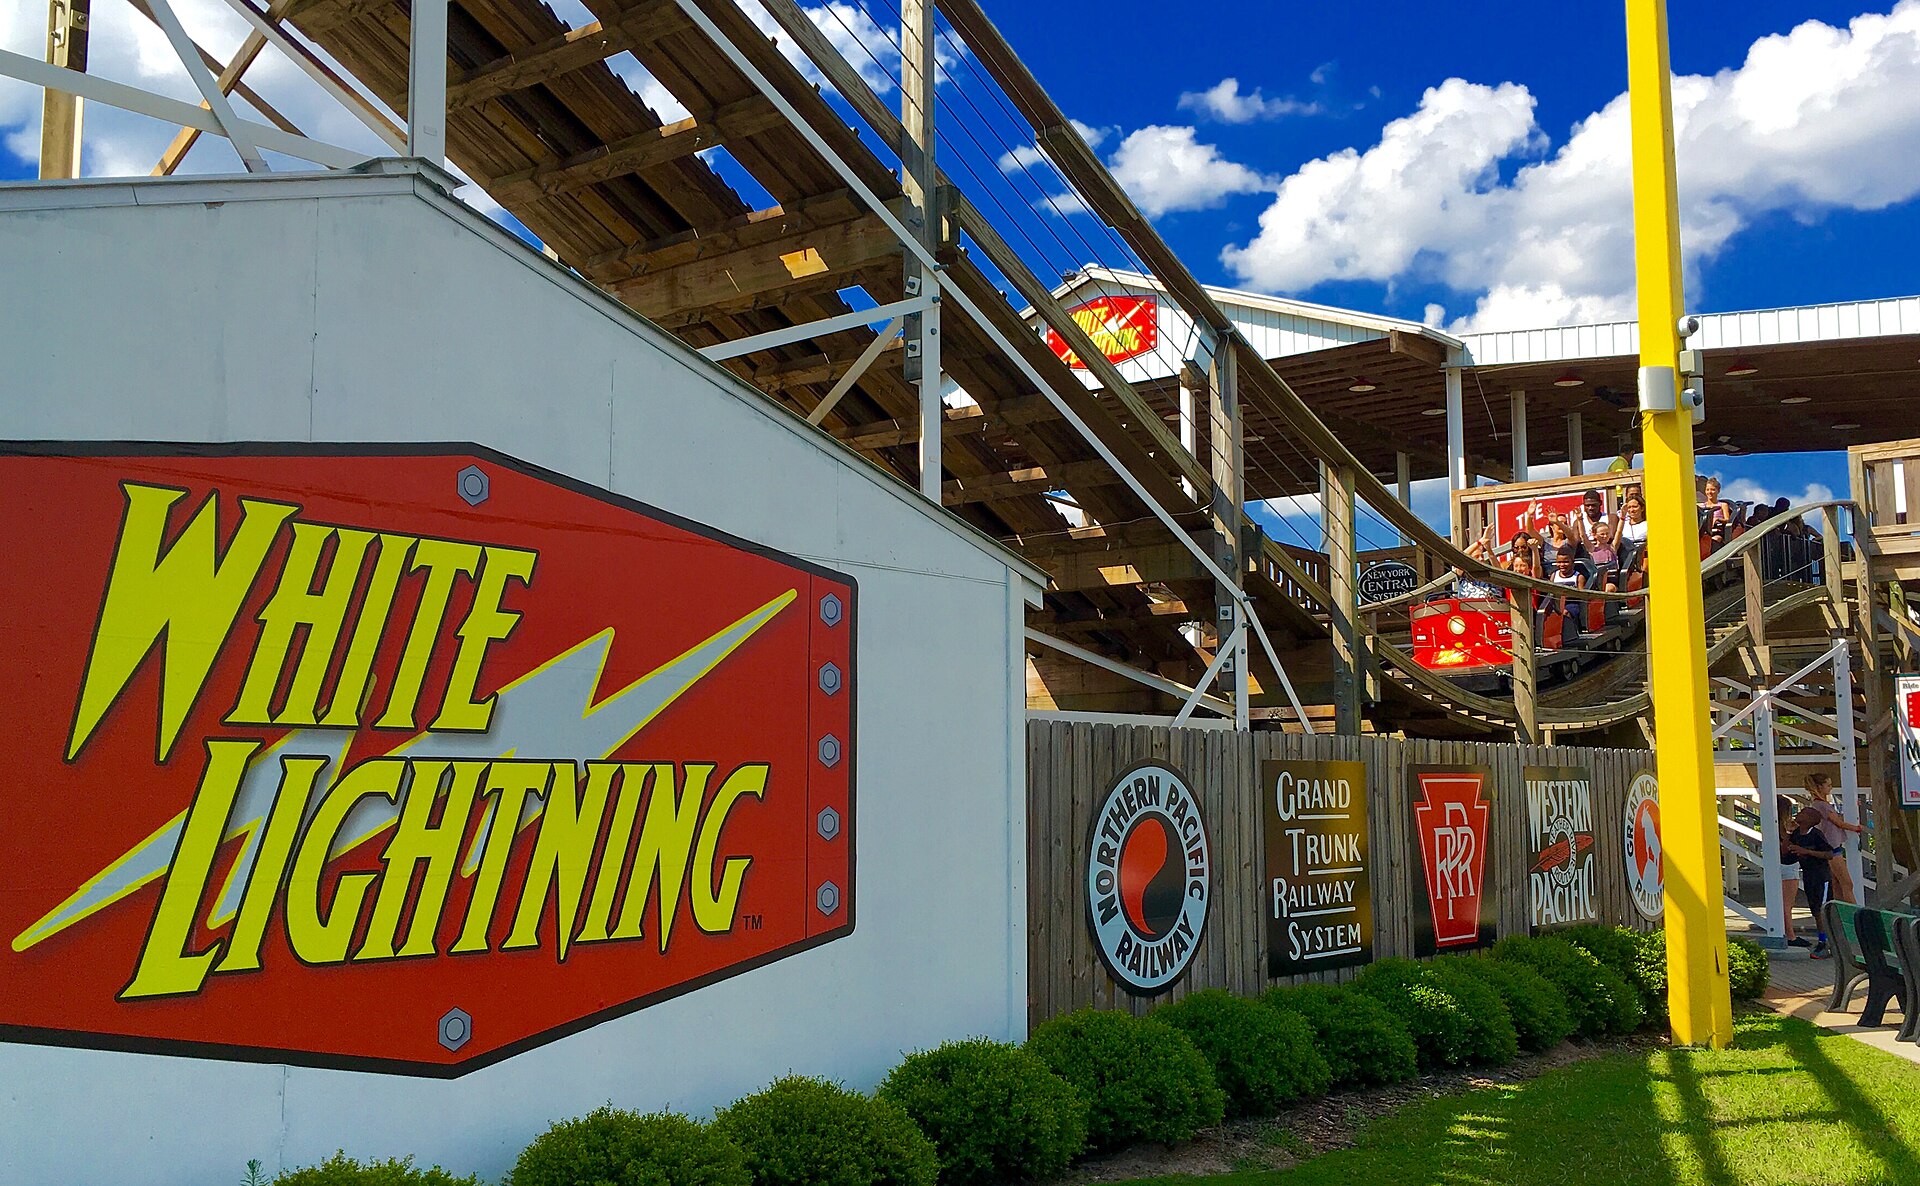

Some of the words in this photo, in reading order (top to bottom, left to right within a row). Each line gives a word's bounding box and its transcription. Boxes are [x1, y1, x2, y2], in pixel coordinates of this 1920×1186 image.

[1516, 503, 1544, 530] TE
[1362, 578, 1418, 597] CENTRAL
[1367, 570, 1386, 581] NEW
[1386, 568, 1411, 578] YORK
[65, 481, 538, 765] WHITE
[1275, 771, 1351, 822] GRAND
[1525, 780, 1593, 853] WESTERN
[1626, 789, 1639, 858] GREAT
[116, 739, 770, 1001] LIGHTNING
[742, 914, 763, 930] TM
[1096, 775, 1161, 926] NORTHERN
[1165, 783, 1206, 902] PACIFIC
[1285, 828, 1363, 876] TRUNK
[1273, 877, 1356, 919] RAILWAY
[1530, 853, 1596, 927] PACIFIC
[1115, 910, 1195, 978] RAILWAY
[1288, 921, 1362, 961] SYSTEM
